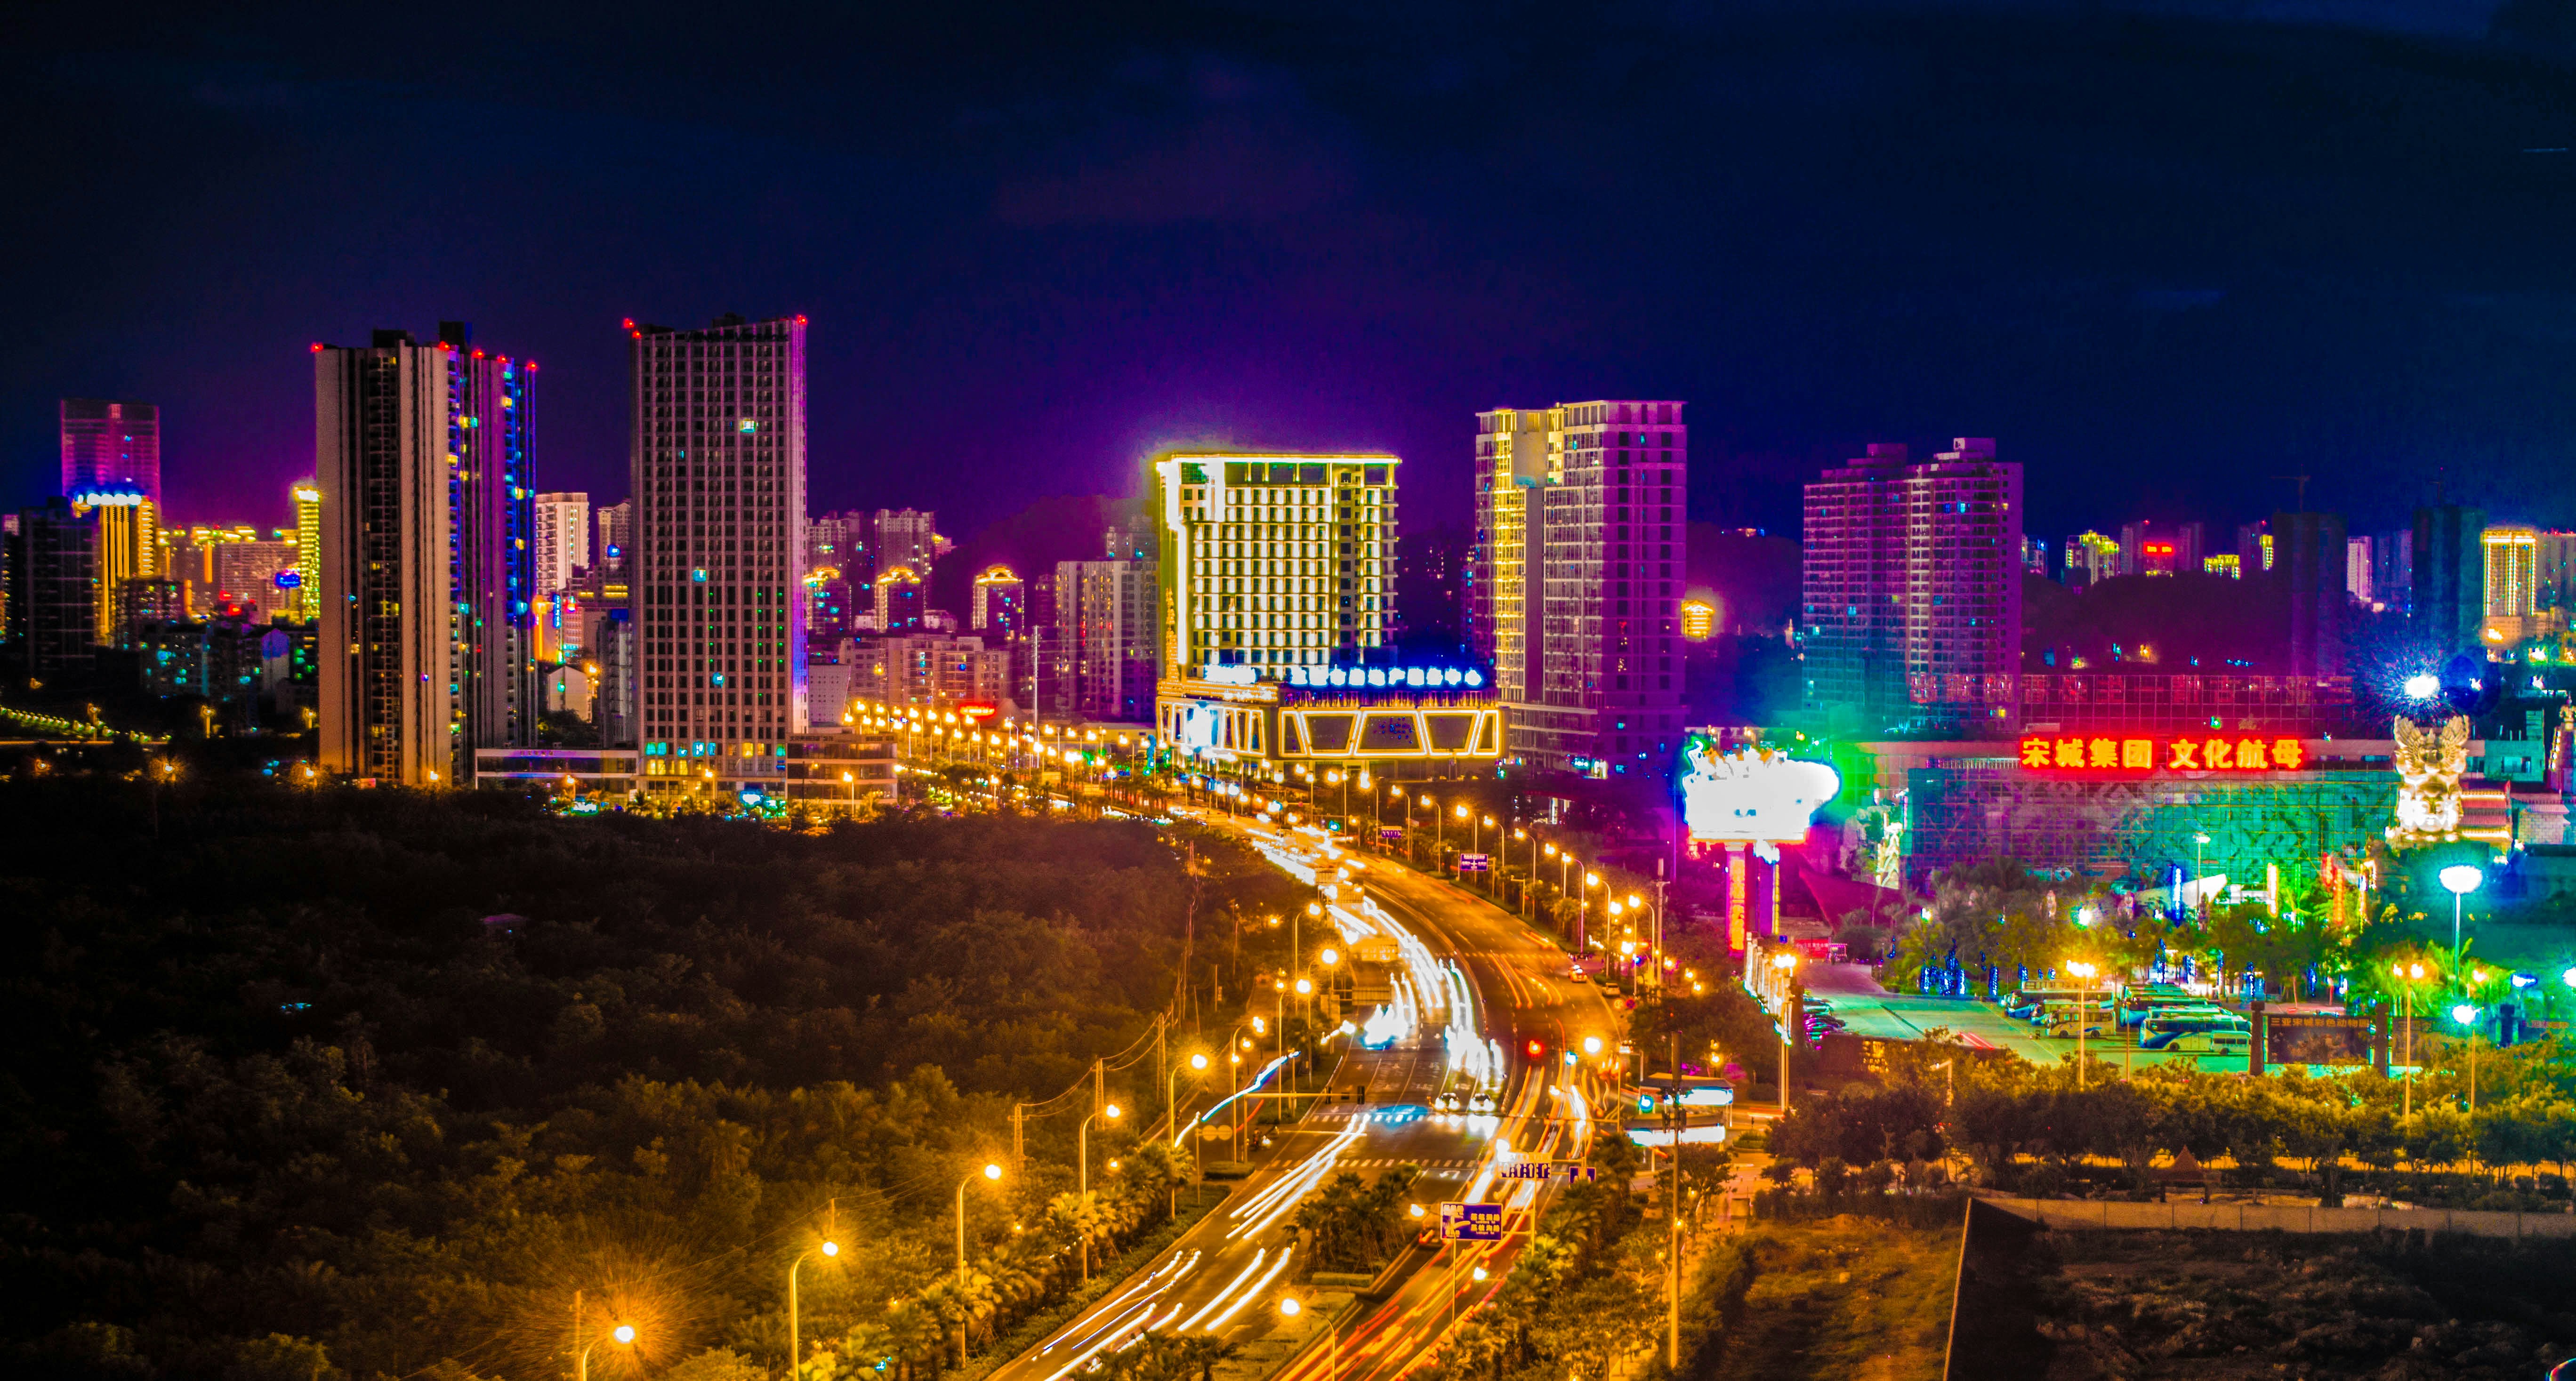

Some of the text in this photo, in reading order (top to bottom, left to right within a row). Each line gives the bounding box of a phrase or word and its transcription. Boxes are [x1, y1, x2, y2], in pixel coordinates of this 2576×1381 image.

[2022, 738, 2302, 769] 宋城集团 文化航母
